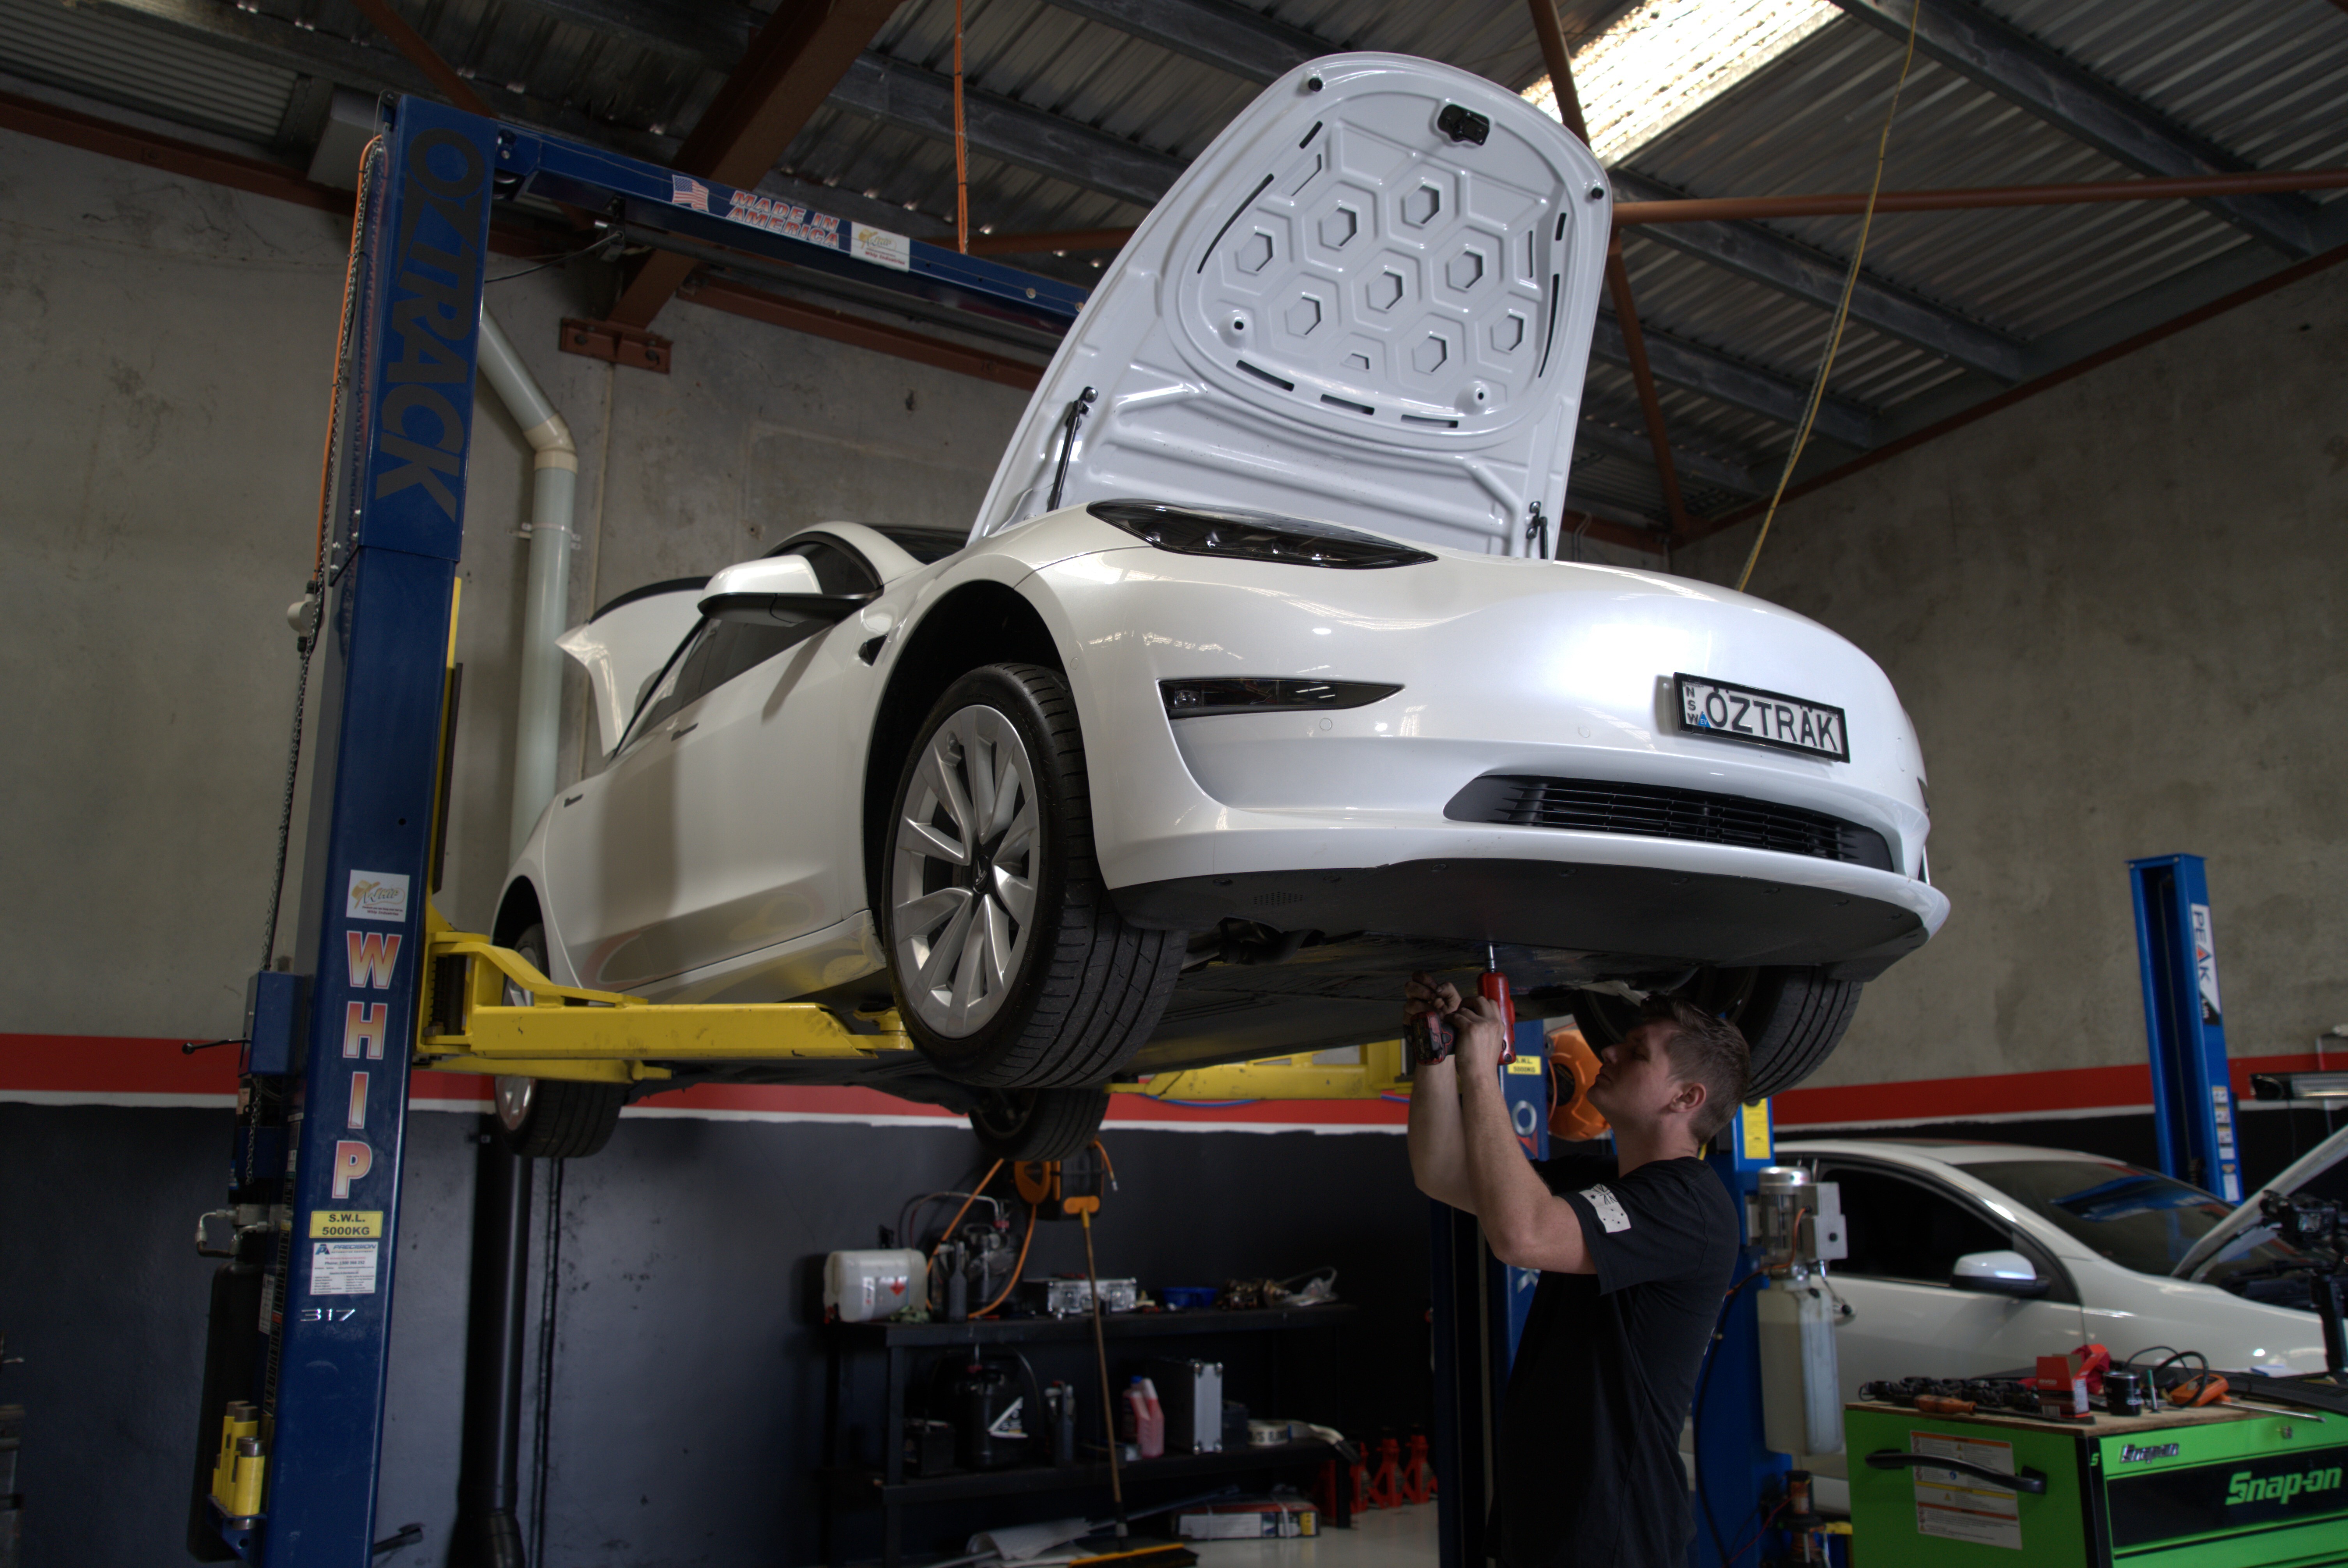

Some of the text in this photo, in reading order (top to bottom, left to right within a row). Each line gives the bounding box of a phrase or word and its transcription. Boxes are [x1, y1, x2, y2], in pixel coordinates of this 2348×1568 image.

[726, 206, 839, 248] AMERICA
[730, 190, 840, 232] MADE IN
[375, 127, 485, 523] OZTRACK
[1685, 686, 1699, 724] NSW
[1706, 692, 1838, 751] OZTRAK
[2194, 911, 2211, 982] PEAK
[332, 931, 402, 1199] WHIP
[322, 1227, 370, 1235] 5000KG
[329, 1214, 365, 1222] S.W.L.
[300, 1308, 355, 1321] 317
[2121, 1443, 2179, 1464] Snap-on
[2225, 1466, 2343, 1506] Snap-on
